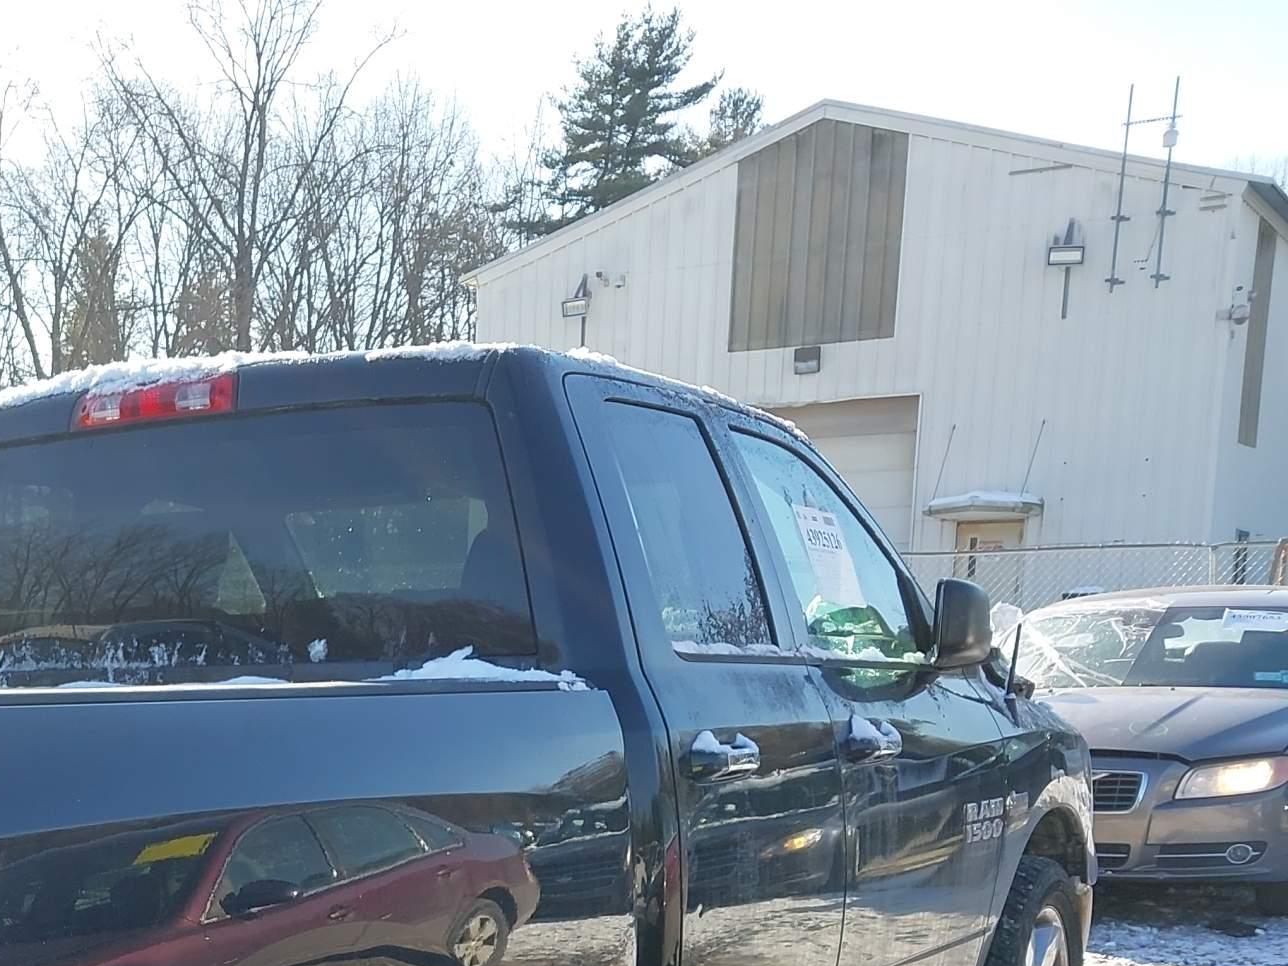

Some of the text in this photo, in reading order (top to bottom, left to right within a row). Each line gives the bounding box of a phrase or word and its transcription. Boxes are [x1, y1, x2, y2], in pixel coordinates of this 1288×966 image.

[806, 528, 843, 551] 43925126
[966, 797, 1004, 822] RAM
[966, 818, 1004, 844] 1500
